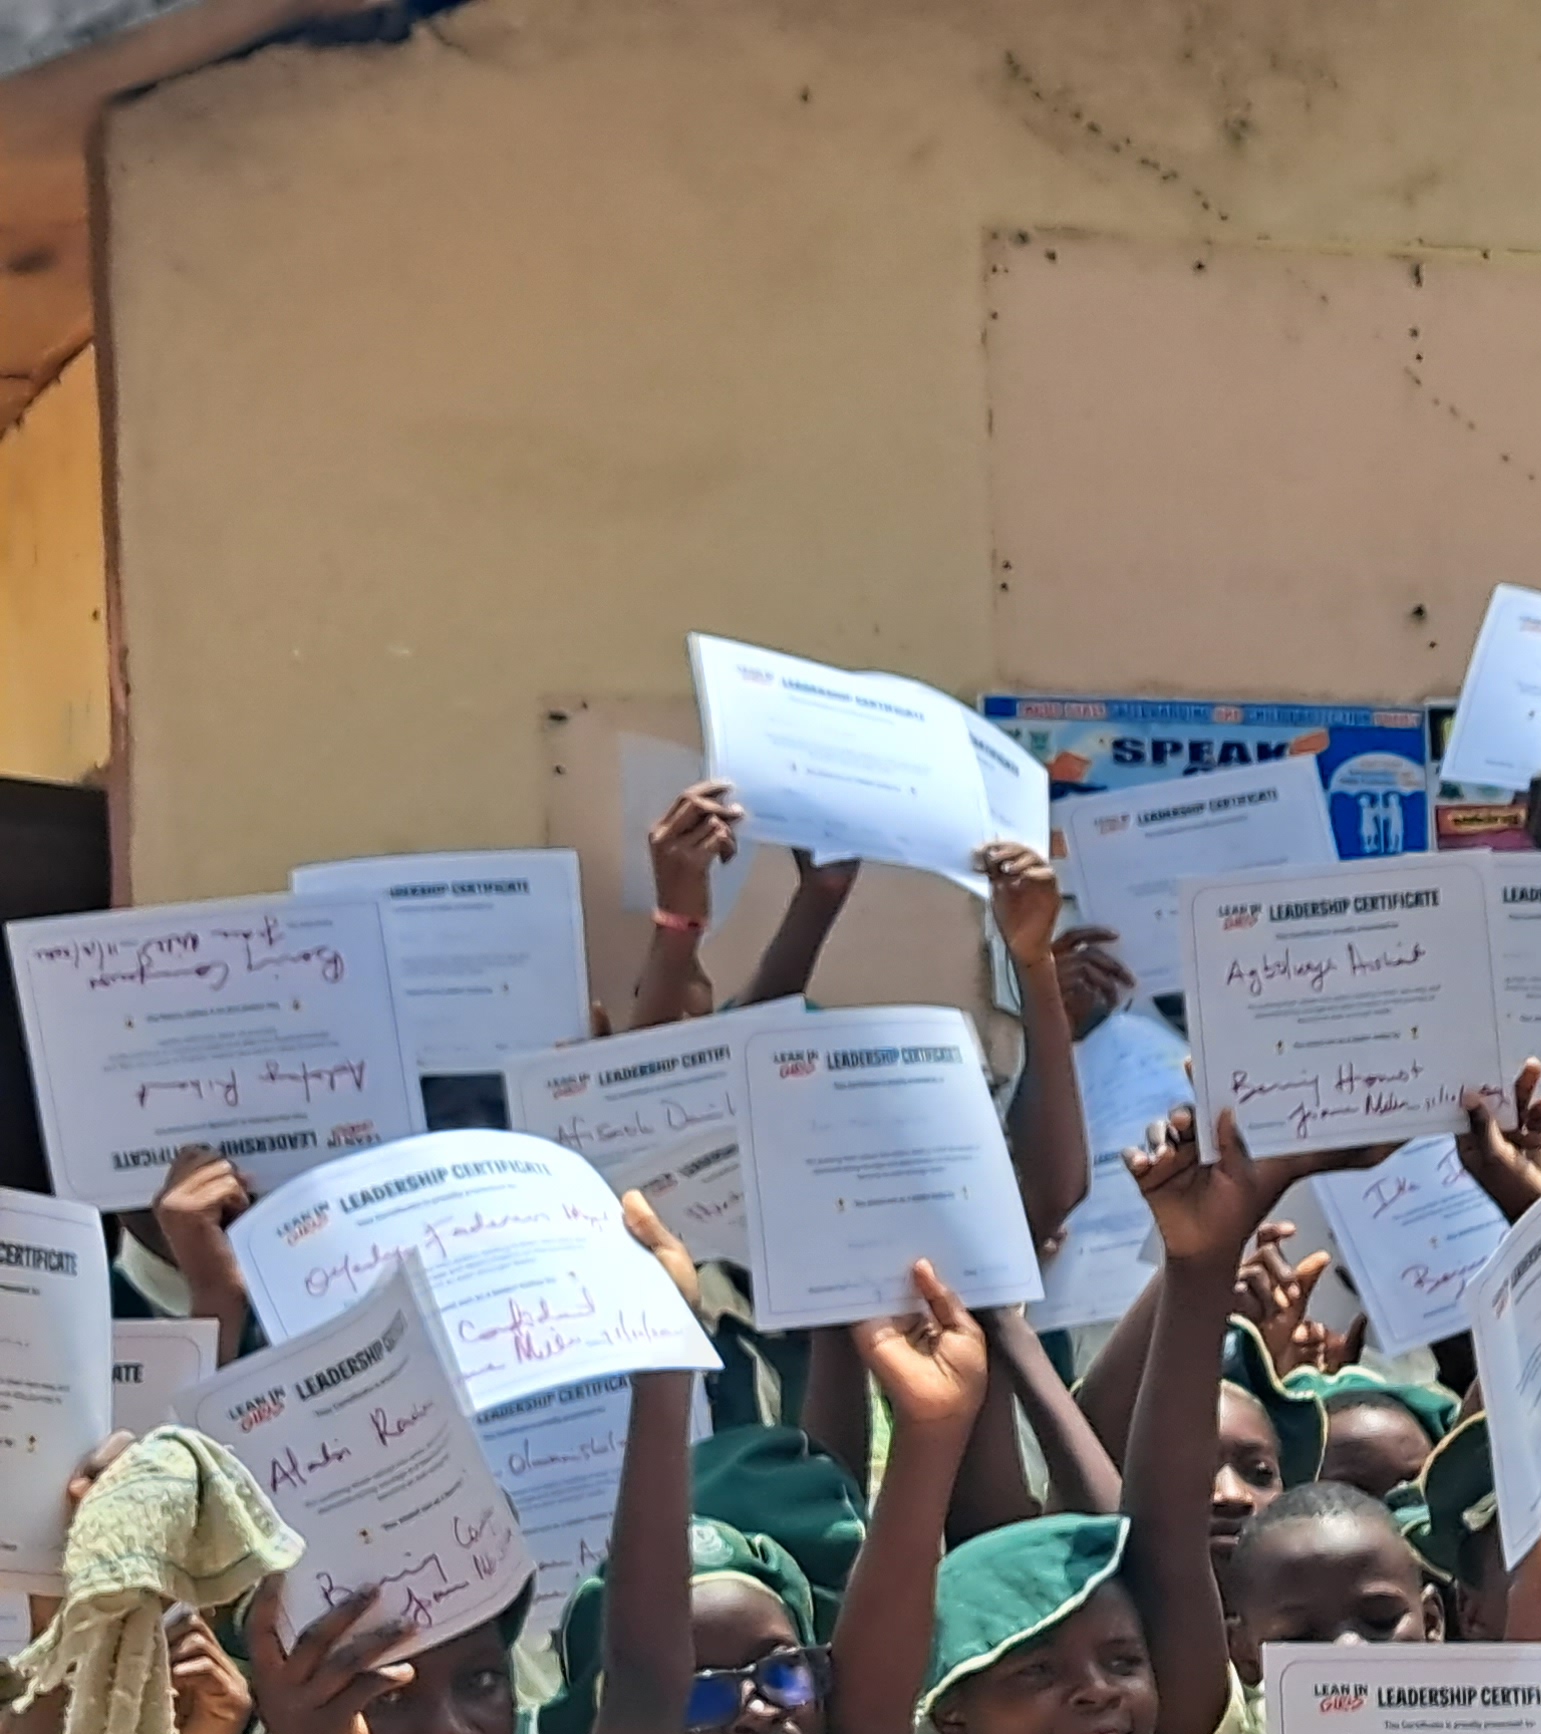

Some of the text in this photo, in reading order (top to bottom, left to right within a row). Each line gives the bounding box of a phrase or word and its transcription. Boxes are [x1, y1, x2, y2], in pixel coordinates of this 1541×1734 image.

[1111, 736, 1291, 764] SPEAK
[1269, 889, 1440, 922] LEADERSHIP CERTIFICATE
[339, 1160, 553, 1214] LEADERSHIP CERTIFICATE
[1377, 1686, 1477, 1707] LEADERSHIP
